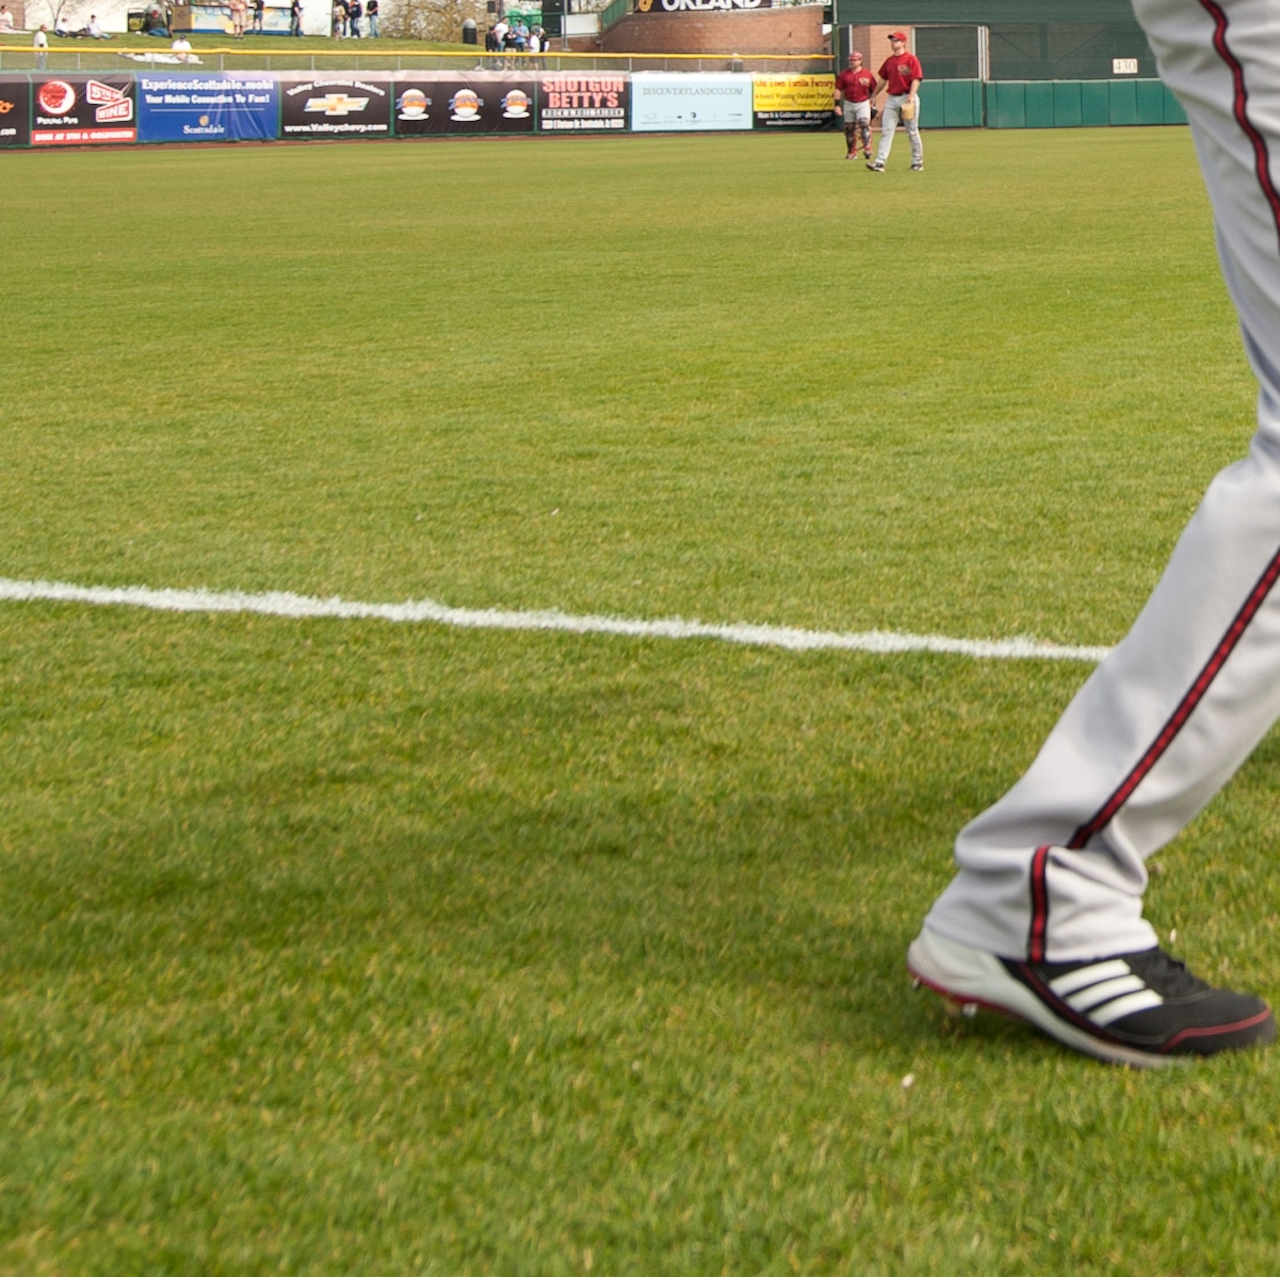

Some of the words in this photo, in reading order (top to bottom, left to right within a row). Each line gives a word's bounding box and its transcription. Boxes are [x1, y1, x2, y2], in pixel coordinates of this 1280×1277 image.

[286, 83, 314, 97] Valley
[541, 76, 625, 93] SHOTGUN
[643, 87, 743, 96] DISCOVERYLANDCO.COM
[234, 93, 247, 103] To
[548, 92, 619, 109] BETTY'S
[97, 102, 129, 121] WINE
[183, 124, 225, 135] Scottsdale
